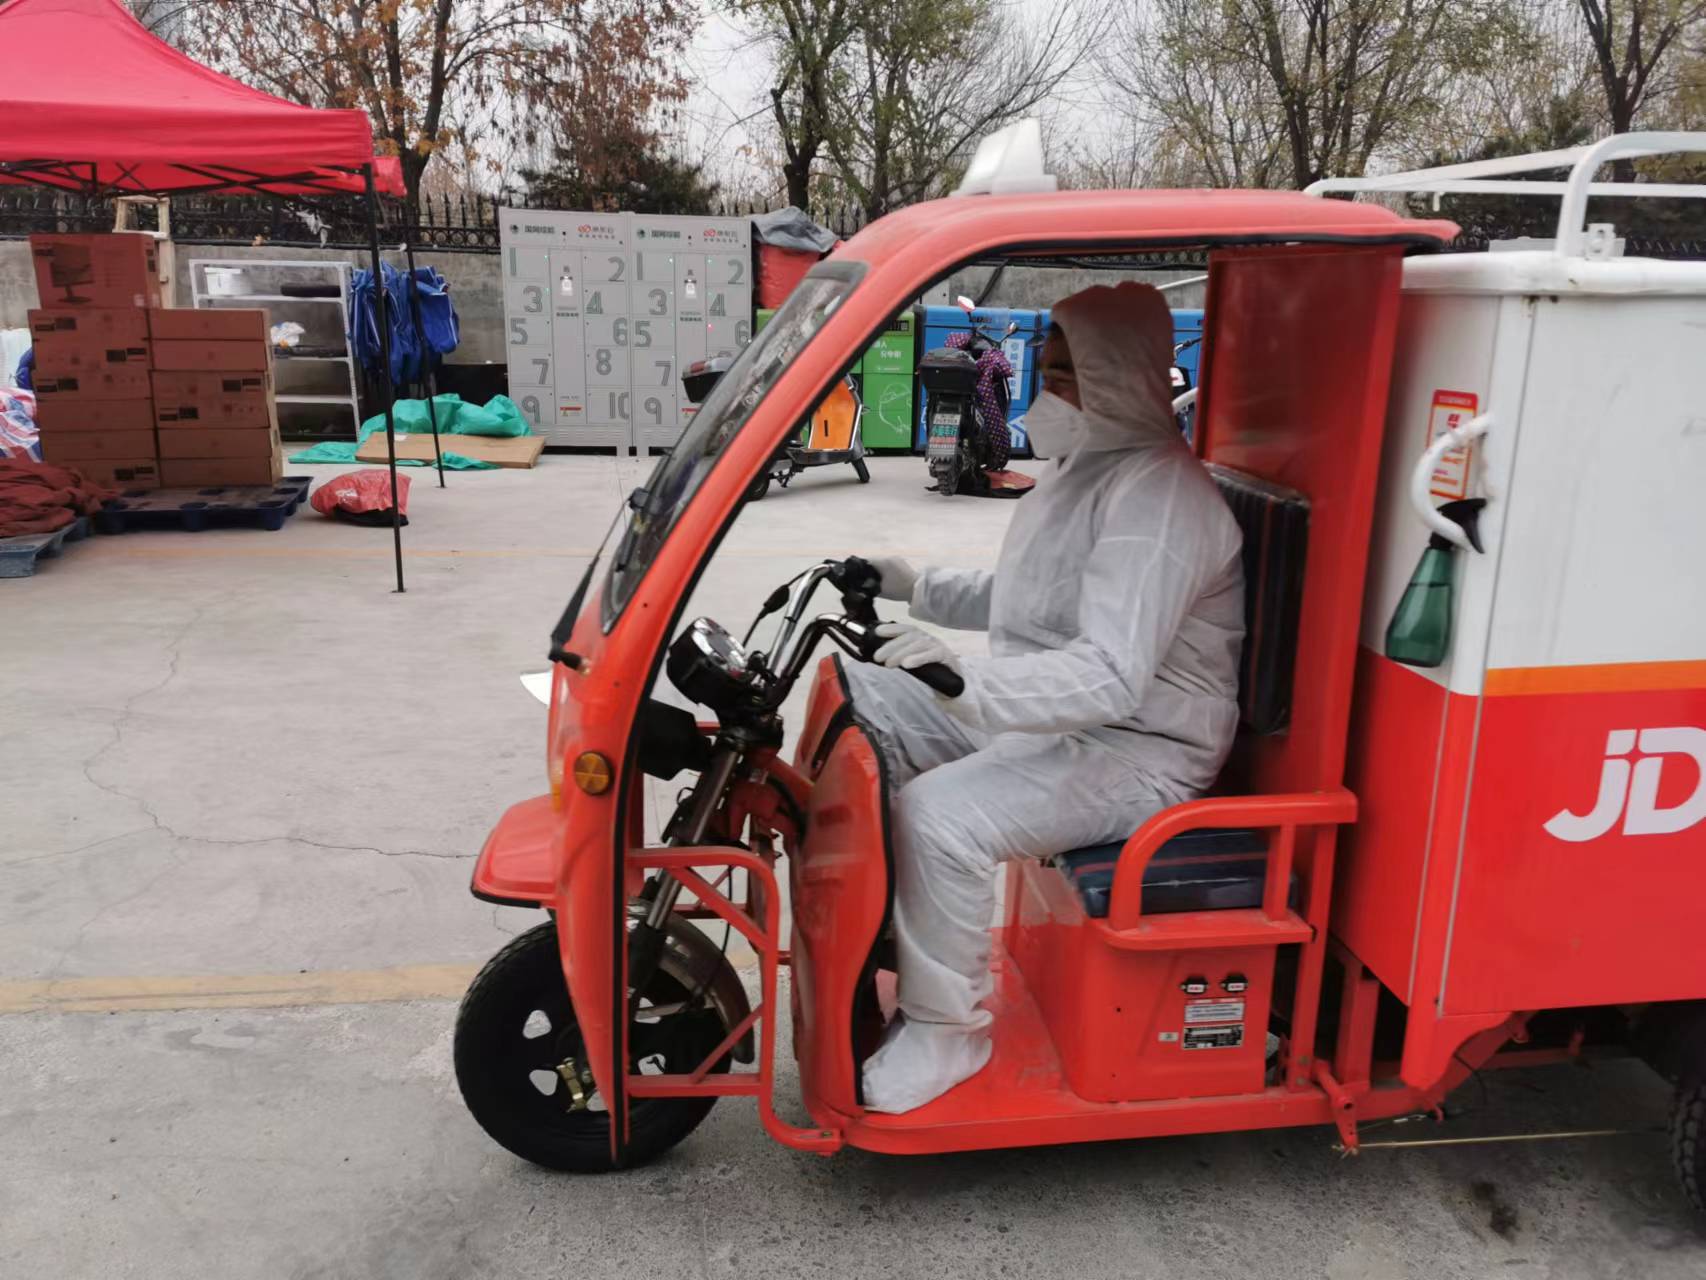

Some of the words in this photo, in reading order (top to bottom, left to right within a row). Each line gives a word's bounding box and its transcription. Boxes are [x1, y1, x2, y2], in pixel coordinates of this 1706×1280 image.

[509, 247, 517, 277] 1
[607, 256, 625, 282] 2
[636, 251, 643, 281] 1
[727, 259, 744, 285] 2
[523, 285, 543, 313] 3
[586, 290, 603, 315] 4
[648, 288, 667, 316] 3
[709, 293, 726, 317] 4
[510, 318, 528, 345] 5
[612, 317, 628, 346] 6
[634, 320, 652, 348] 5
[734, 319, 749, 349] 6
[531, 358, 549, 385] 7
[596, 348, 612, 376] 8
[655, 360, 671, 386] 7
[521, 395, 541, 424] 9
[644, 397, 662, 425] 9
[1542, 726, 1706, 842] JD
